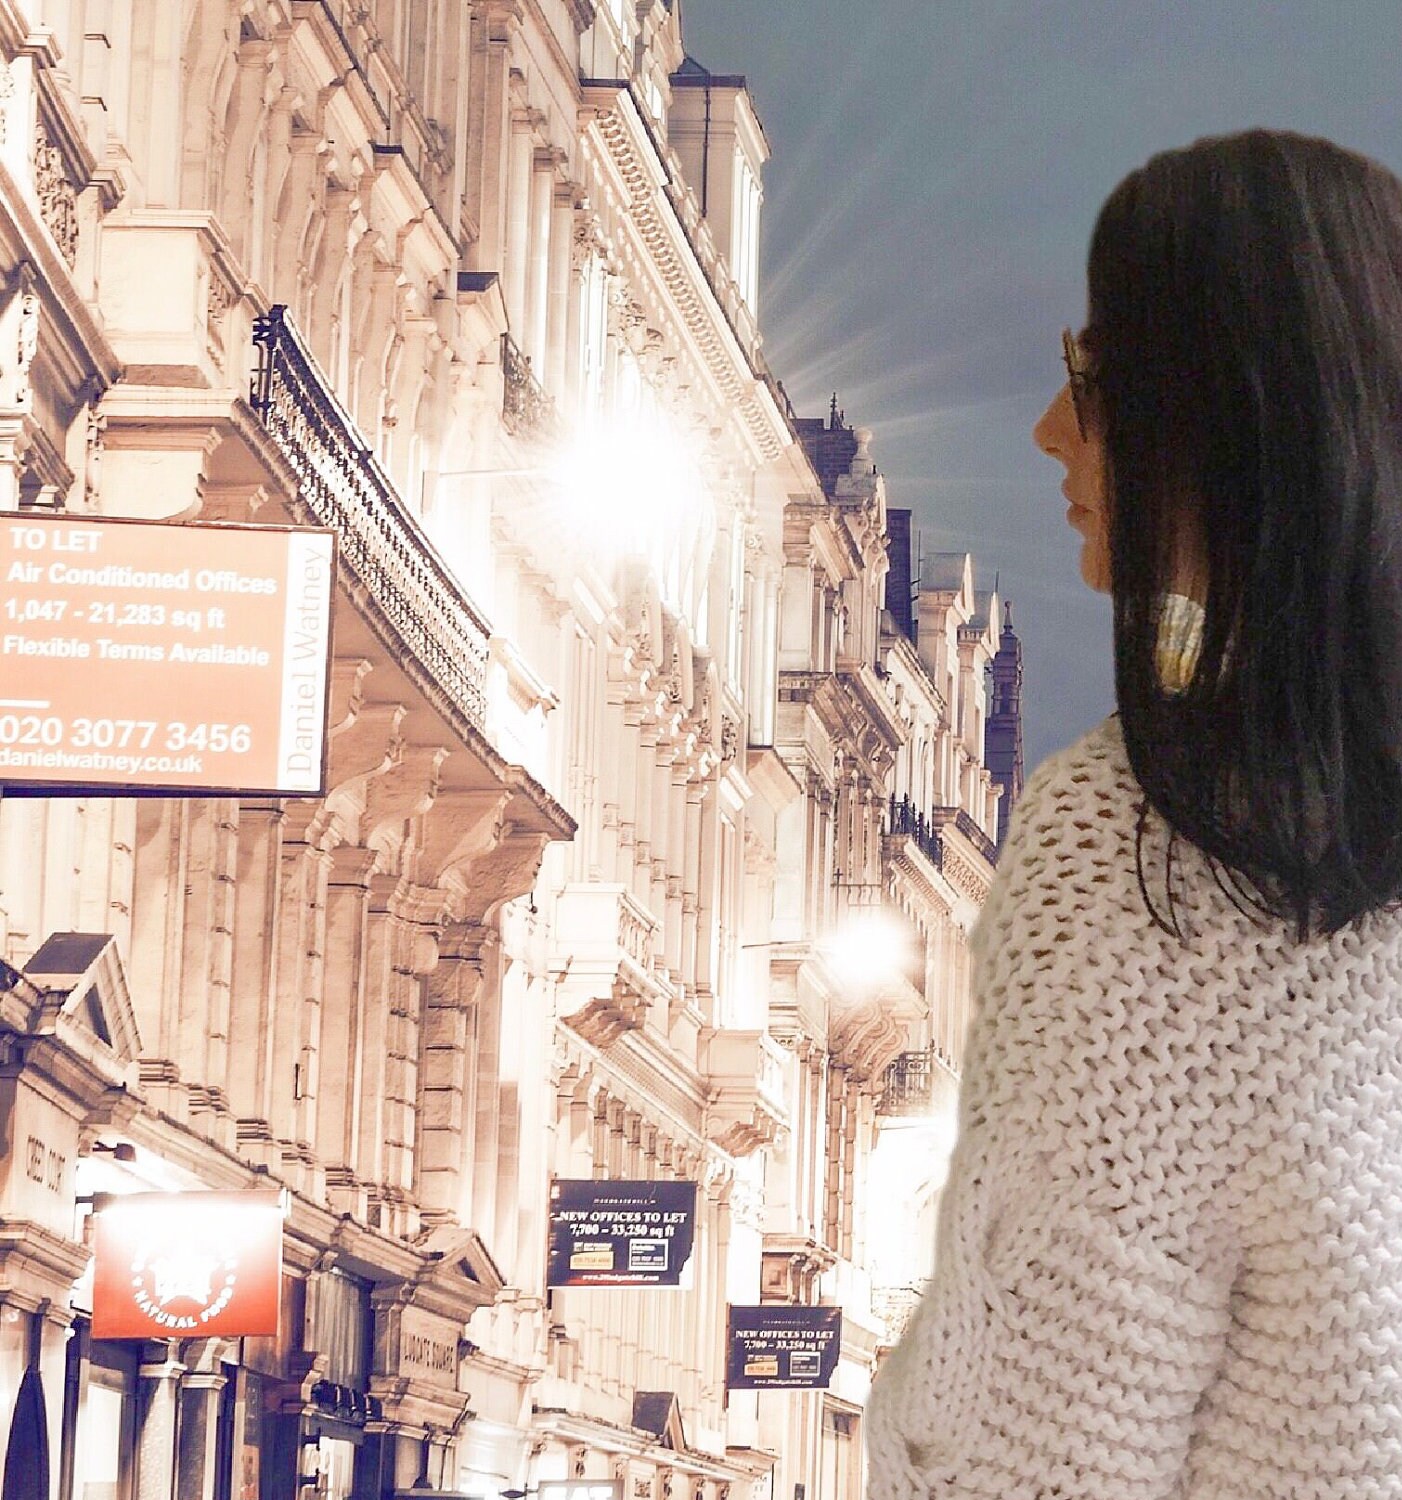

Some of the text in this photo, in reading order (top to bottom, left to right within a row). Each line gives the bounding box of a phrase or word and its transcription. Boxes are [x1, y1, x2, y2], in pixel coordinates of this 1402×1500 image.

[10, 527, 103, 552] TO LET
[7, 561, 277, 595] Air Conditioned Offices
[4, 599, 68, 622] 1,047
[89, 603, 165, 628] 21,283
[171, 609, 201, 632] sq
[207, 608, 226, 629] ft
[292, 546, 329, 661] Watney
[4, 635, 270, 667] Flexible Terms Available
[0, 715, 251, 753] 020 3077 3456
[559, 1212, 687, 1223] NEW OFFICES TO LET
[649, 1228, 663, 1239] sq
[134, 1290, 198, 1328] NATURAL
[760, 1331, 799, 1339] OFFICES
[801, 1331, 814, 1339] TO
[816, 1331, 834, 1339] LET
